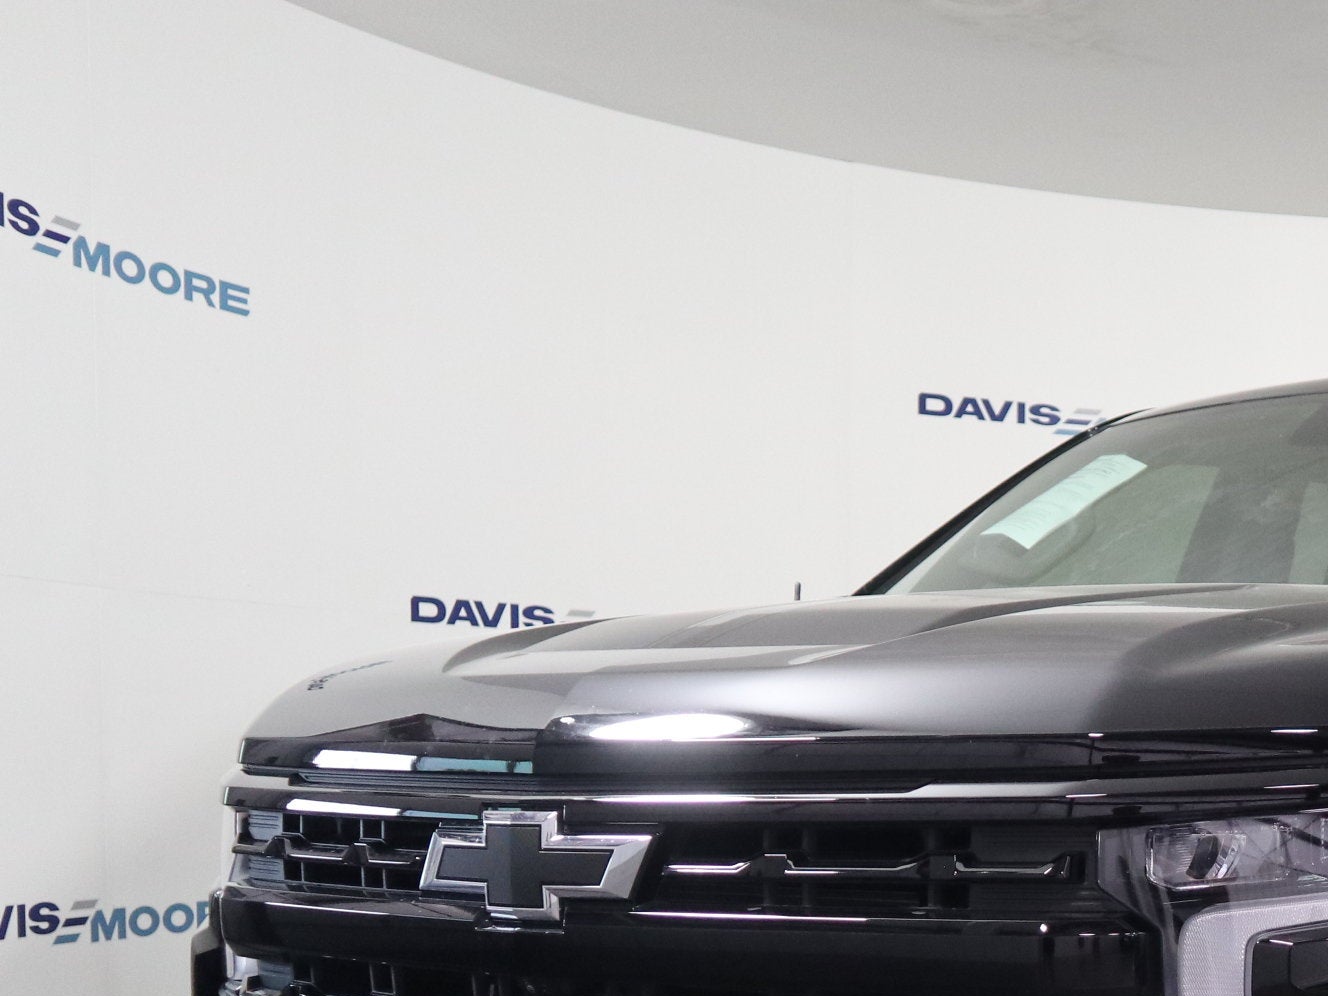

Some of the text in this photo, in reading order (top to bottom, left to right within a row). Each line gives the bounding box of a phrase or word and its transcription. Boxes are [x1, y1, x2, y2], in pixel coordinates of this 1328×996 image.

[72, 234, 250, 317] MOORE
[917, 391, 1061, 426] DAVIS
[409, 595, 555, 629] DAVIS
